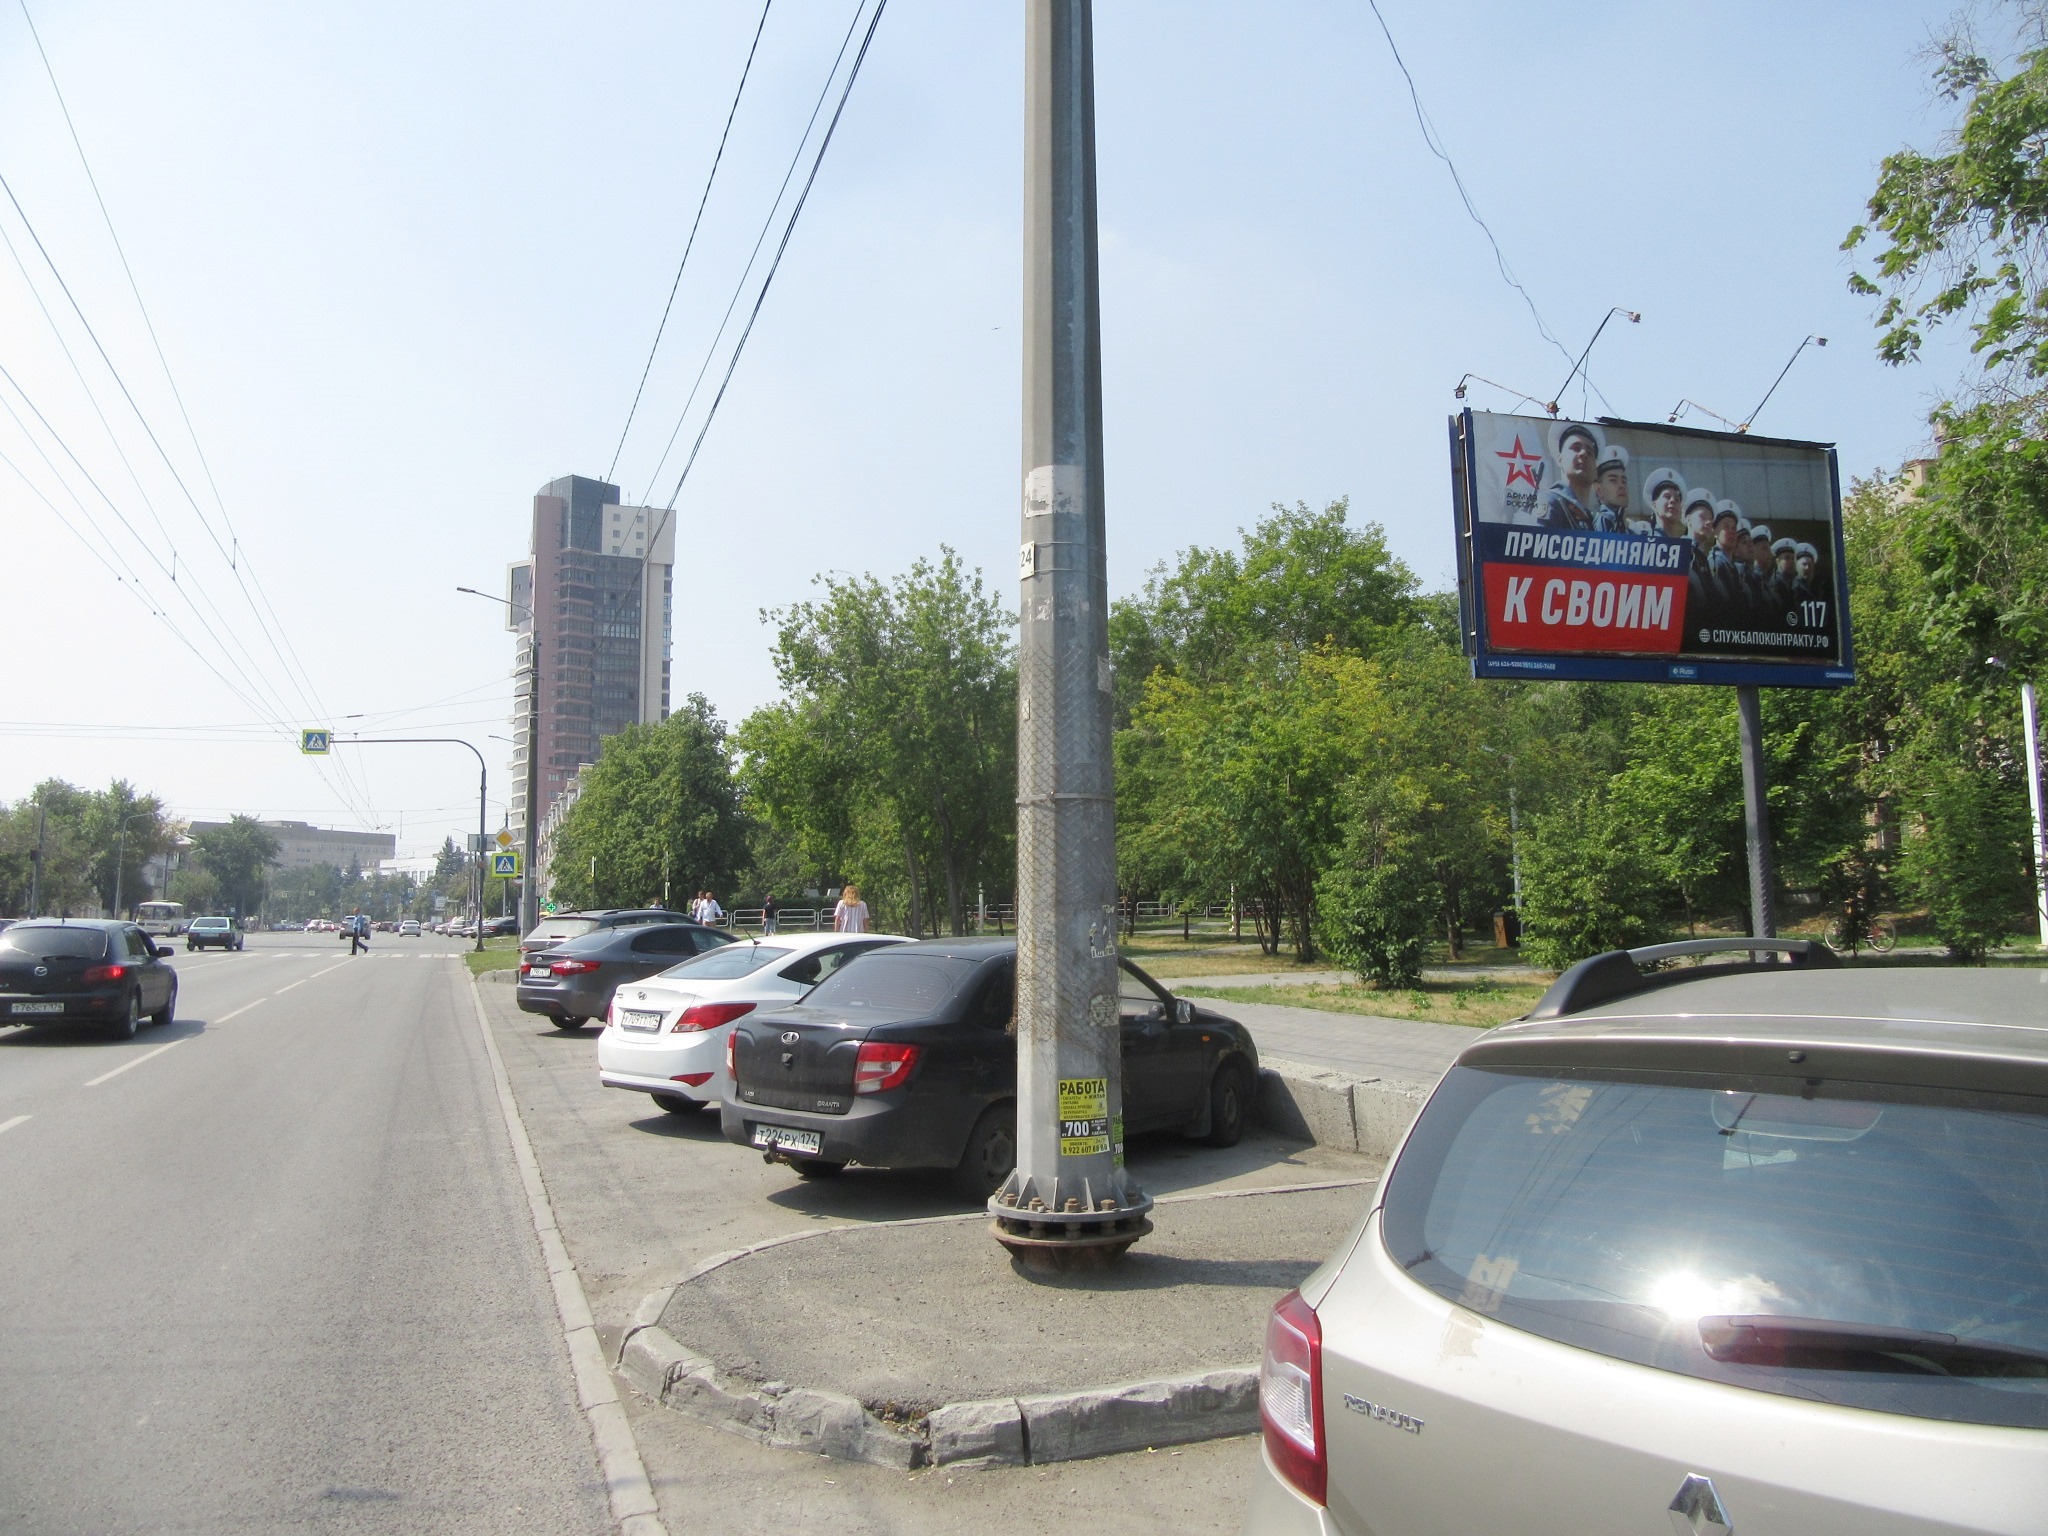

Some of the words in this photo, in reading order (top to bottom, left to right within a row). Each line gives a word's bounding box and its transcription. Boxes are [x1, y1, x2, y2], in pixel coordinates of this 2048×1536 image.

[1504, 531, 1681, 568] ПРИСОЕДИНЯЙСЯ
[1503, 577, 1533, 623] К
[1541, 578, 1673, 630] СВОИМ
[1800, 600, 1827, 627] 117
[1713, 629, 1829, 648] СЛУЖБАПОКОНТРАКТУ.РФ
[1060, 1080, 1105, 1096] РАБОТА
[817, 1100, 840, 1108] GRANTA
[1065, 1121, 1089, 1137] 700
[1344, 1393, 1424, 1435] RENAULT
